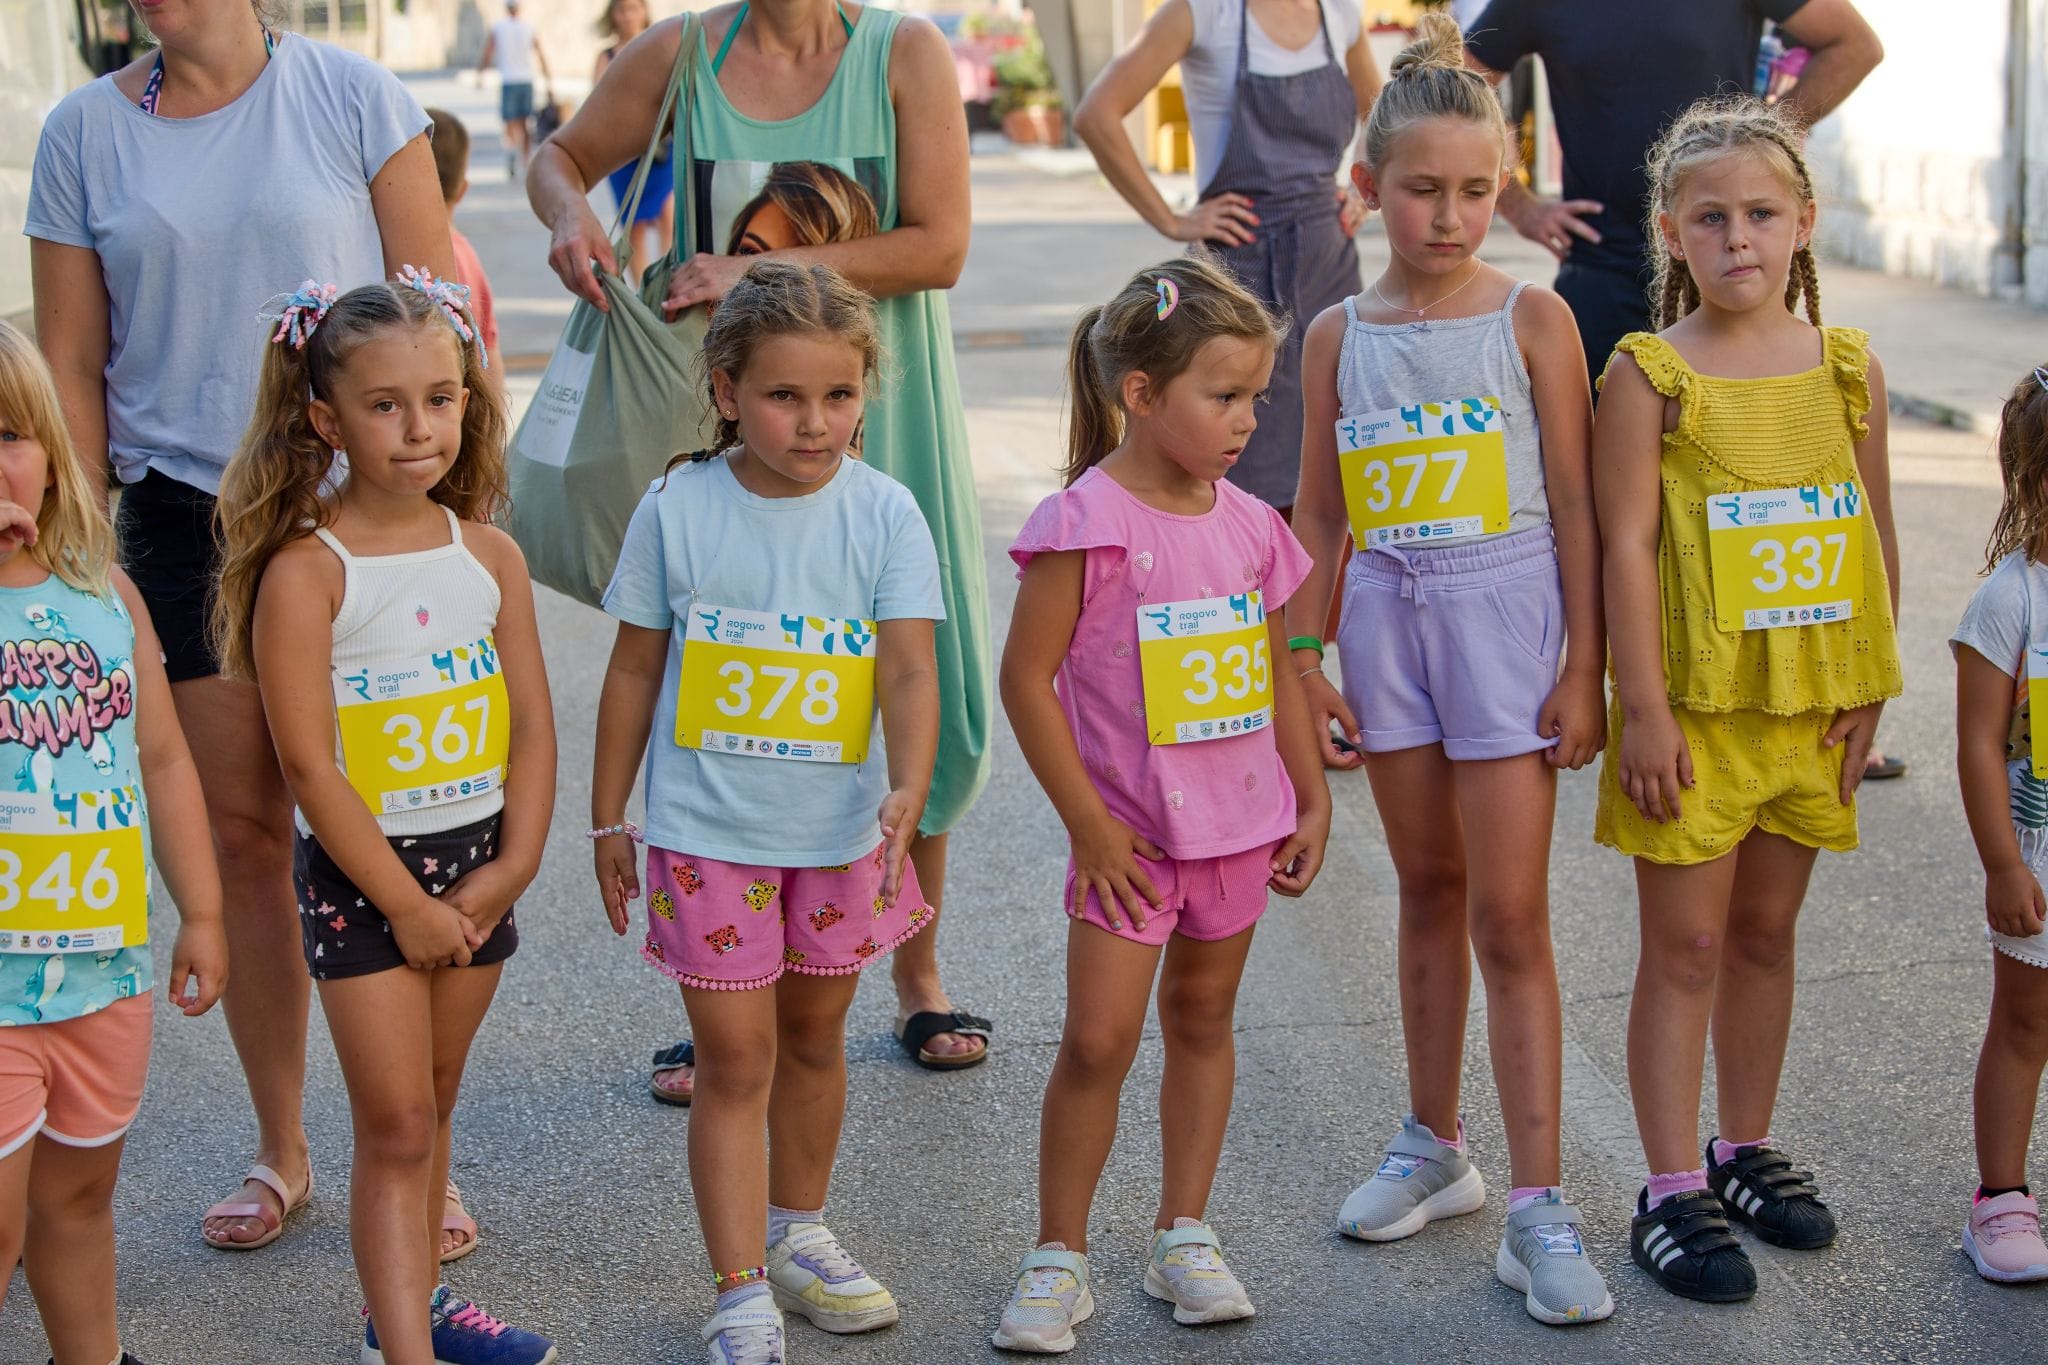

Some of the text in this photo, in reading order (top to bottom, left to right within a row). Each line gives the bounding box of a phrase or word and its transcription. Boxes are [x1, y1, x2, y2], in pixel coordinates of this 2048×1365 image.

[1362, 433, 1376, 441] trail
[1364, 449, 1468, 513] 377
[1749, 510, 1768, 519] trail
[1750, 533, 1847, 593] 337
[726, 629, 745, 639] trail
[1179, 620, 1199, 630] trail
[0, 638, 103, 695] APPY
[1180, 639, 1267, 705] 335
[378, 683, 400, 694] trail
[715, 660, 839, 725] 378
[0, 668, 133, 758] UMMER
[382, 695, 490, 772] 367
[0, 804, 36, 816] ogovo
[0, 815, 12, 825] ail
